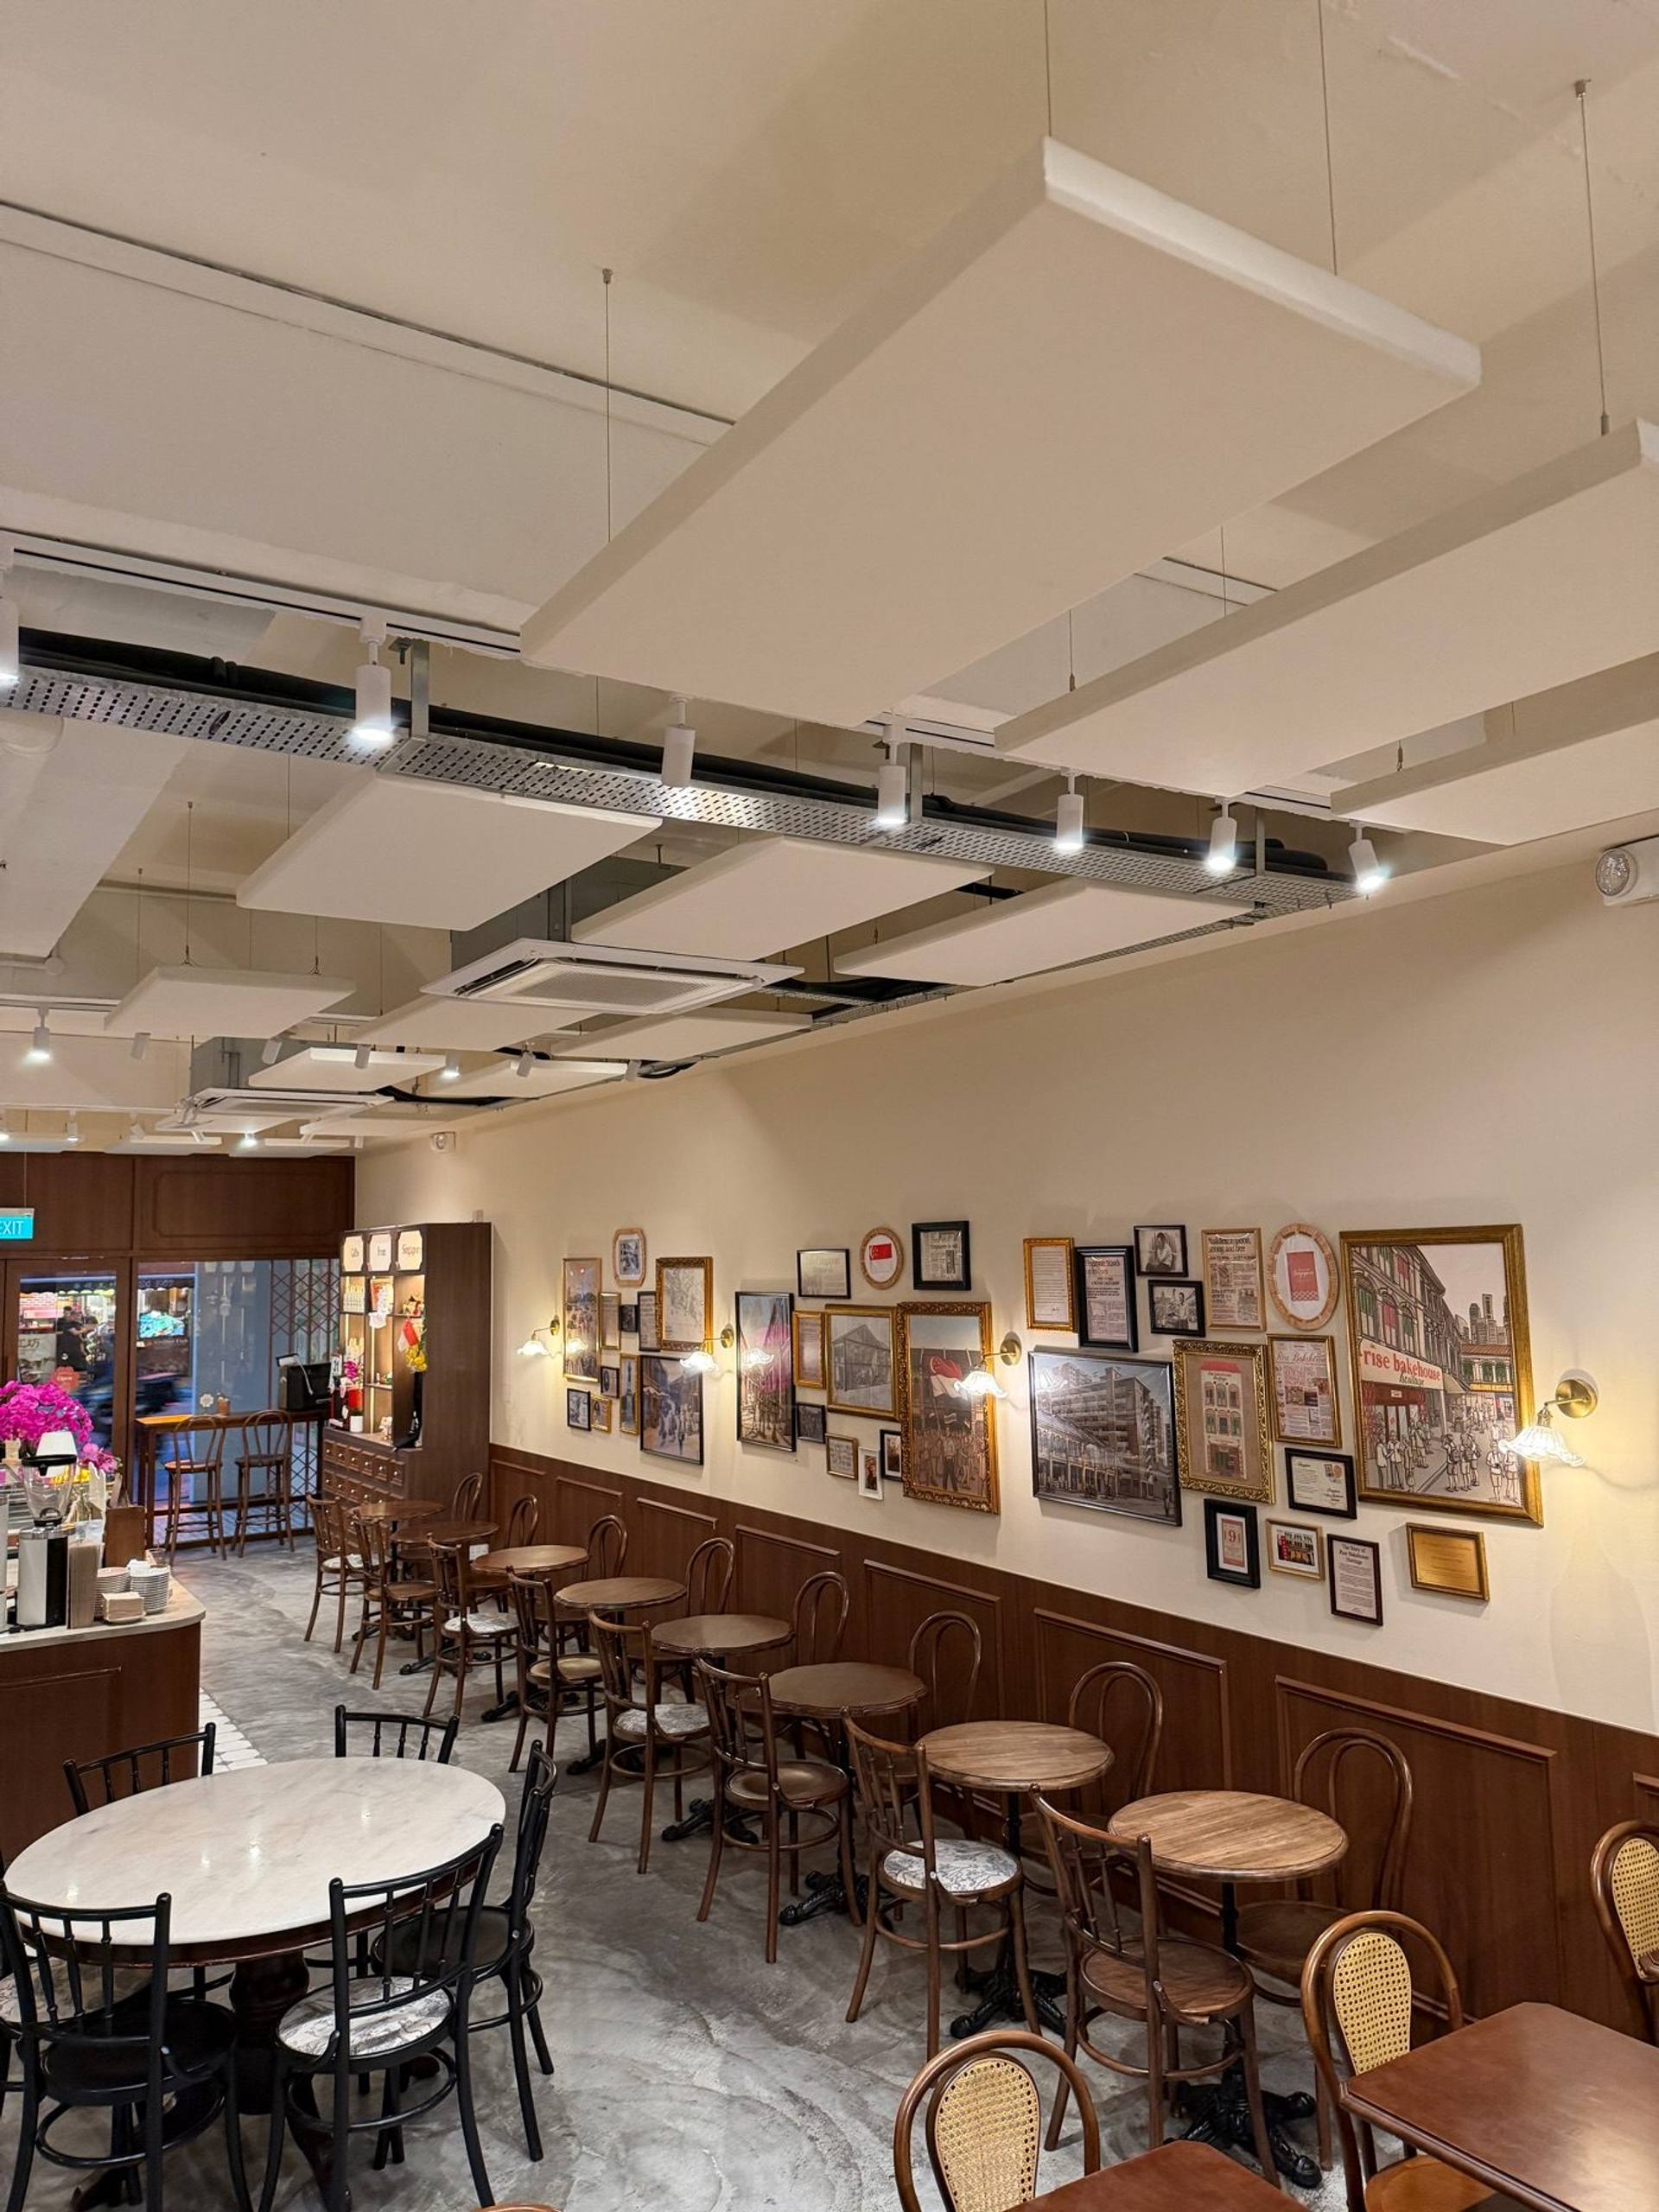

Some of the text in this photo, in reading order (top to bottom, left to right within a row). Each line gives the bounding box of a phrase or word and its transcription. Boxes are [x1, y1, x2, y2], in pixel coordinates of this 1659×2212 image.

[1363, 1350, 1441, 1381] rise bakehouse
[1229, 1529, 1236, 1542] 9
